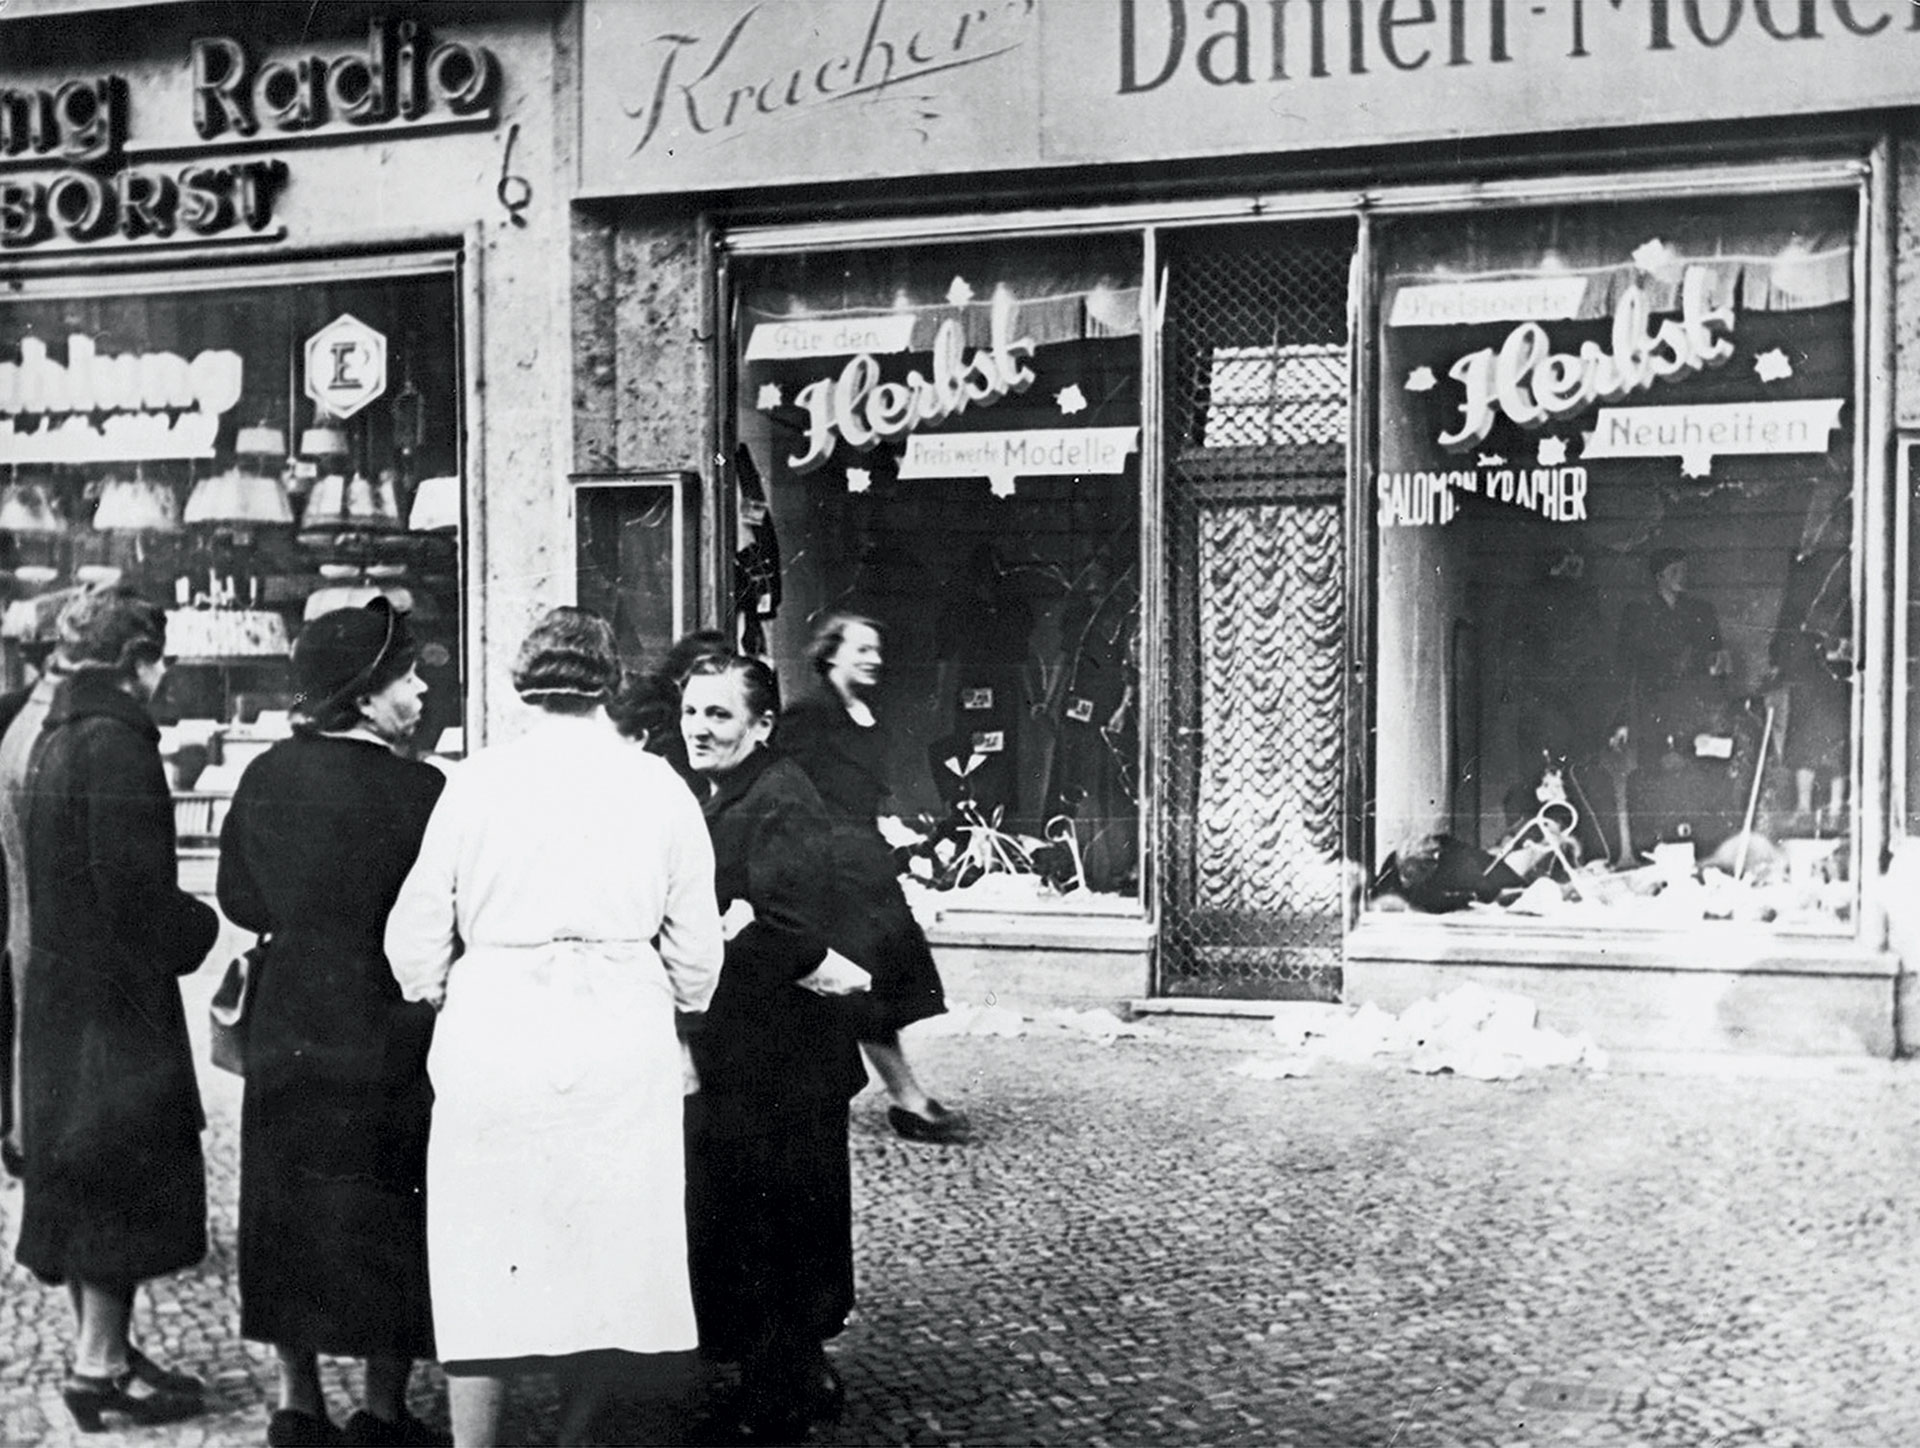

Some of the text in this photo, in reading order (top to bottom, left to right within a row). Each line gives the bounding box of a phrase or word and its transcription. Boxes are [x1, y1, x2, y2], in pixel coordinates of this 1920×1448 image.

[189, 16, 500, 140] Radio
[833, 325, 881, 349] den
[1438, 266, 1735, 453] Herbst
[788, 284, 1035, 472] Herbst
[1003, 437, 1117, 467] Modelle
[1608, 412, 1809, 448] Neuheiten
